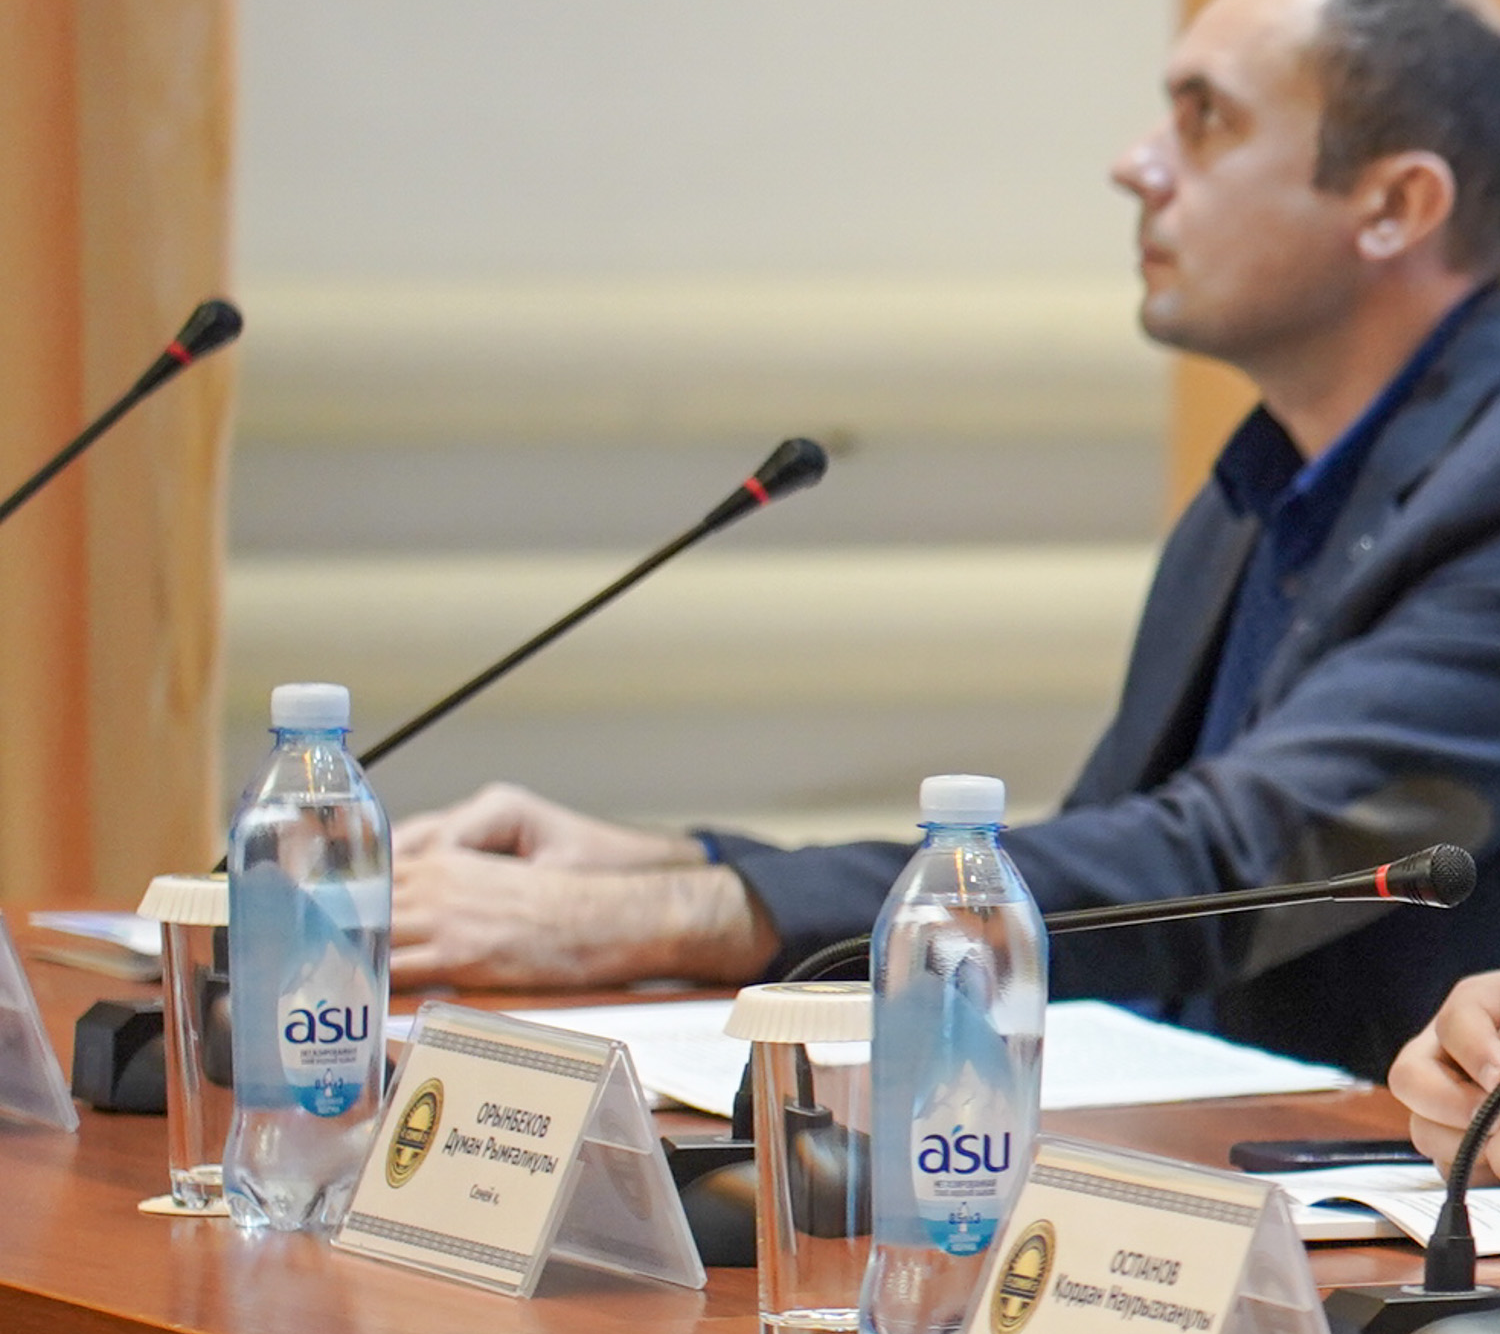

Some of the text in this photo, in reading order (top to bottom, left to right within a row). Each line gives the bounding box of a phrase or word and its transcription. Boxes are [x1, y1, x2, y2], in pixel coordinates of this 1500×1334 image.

[476, 1102, 551, 1138] ОРЫНБЕКОВ
[442, 1128, 482, 1157] Думан
[1109, 1249, 1182, 1286] ОСПАНОВ
